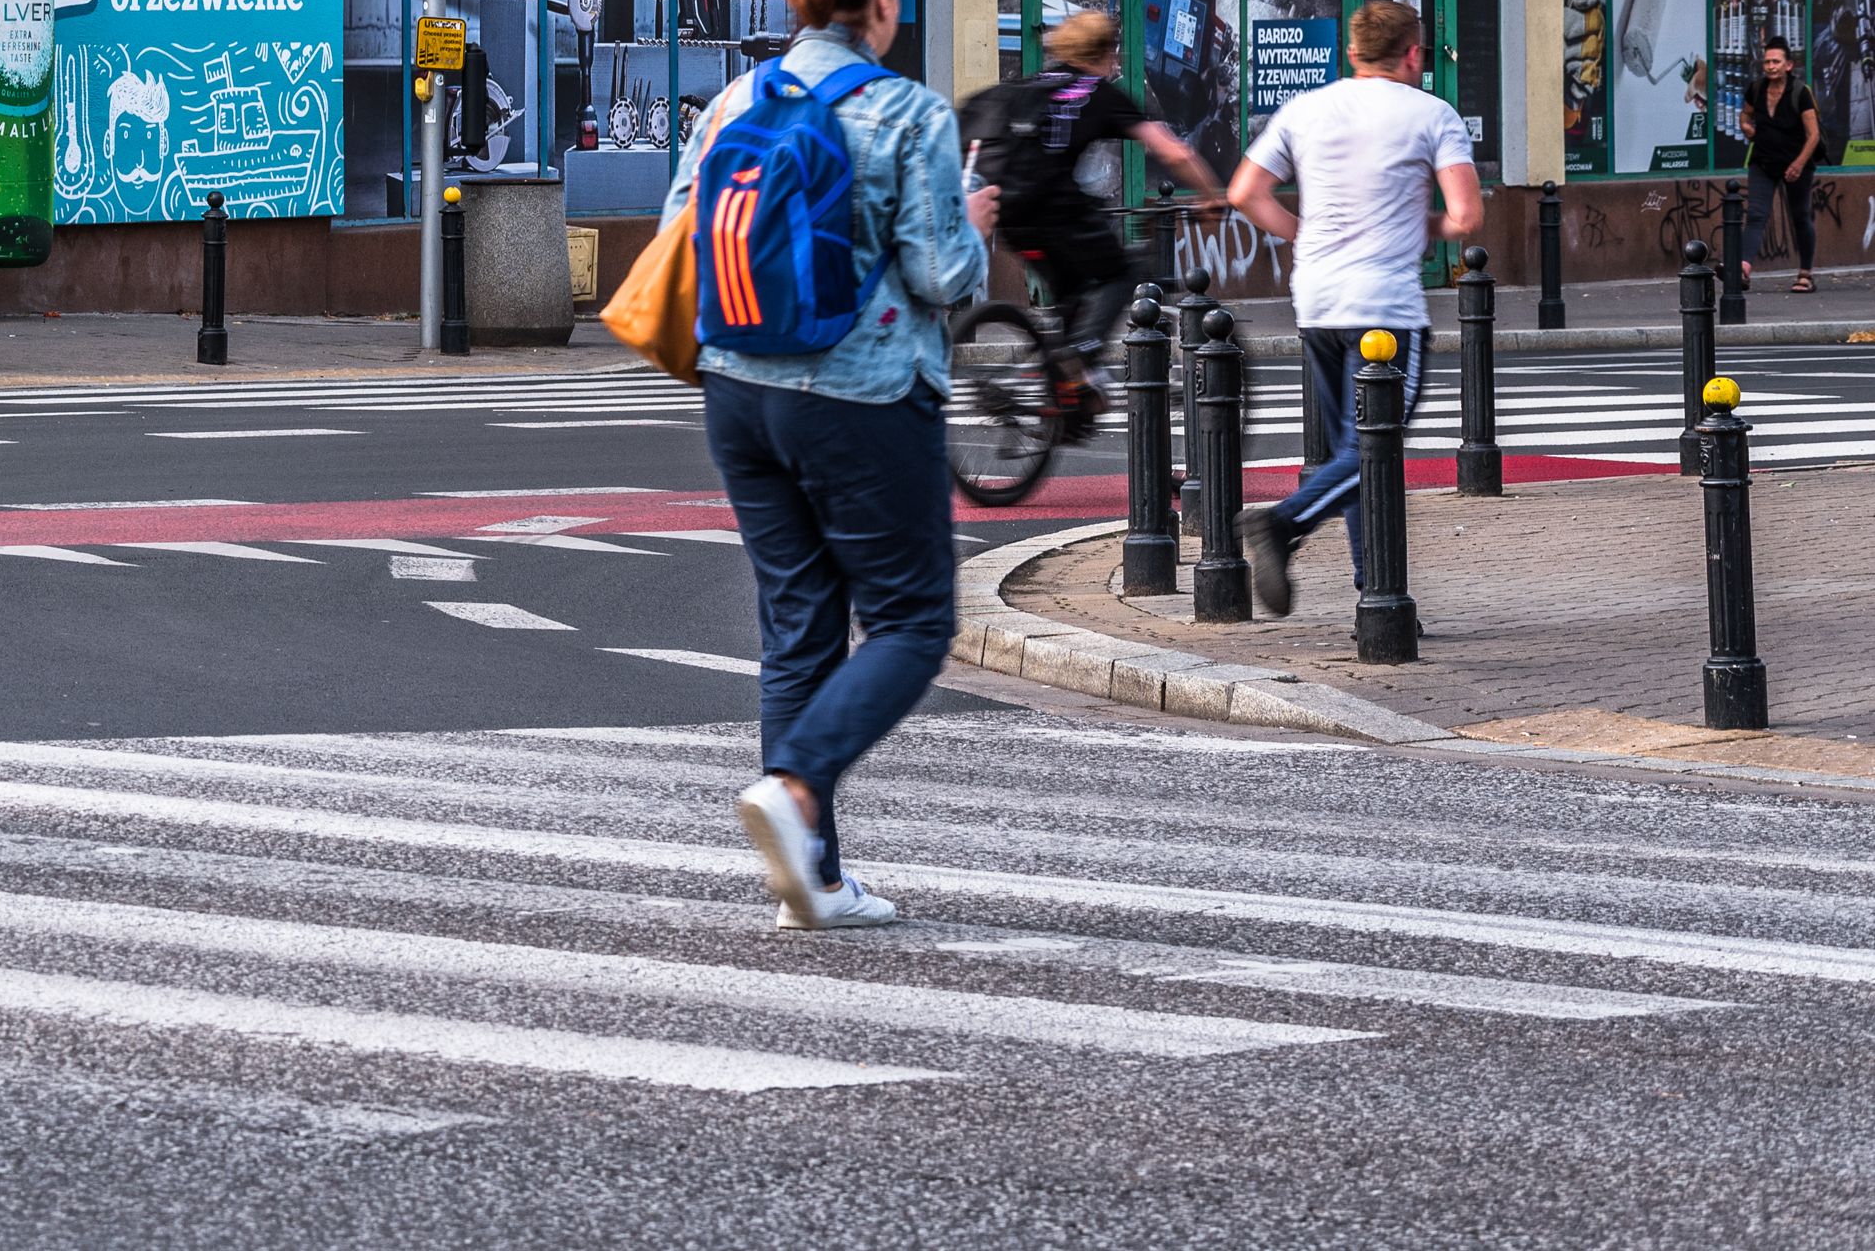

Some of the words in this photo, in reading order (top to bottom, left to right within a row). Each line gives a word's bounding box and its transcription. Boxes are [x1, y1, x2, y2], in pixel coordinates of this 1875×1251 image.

[9, 30, 32, 40] EXTRA
[1257, 27, 1303, 44] BARDZO
[10, 53, 32, 63] TASTE
[1257, 47, 1332, 65] WYTRZYMAŁY
[1257, 70, 1265, 86] Z
[1266, 67, 1326, 87] ZEWNĄTRZ
[1263, 89, 1276, 106] W
